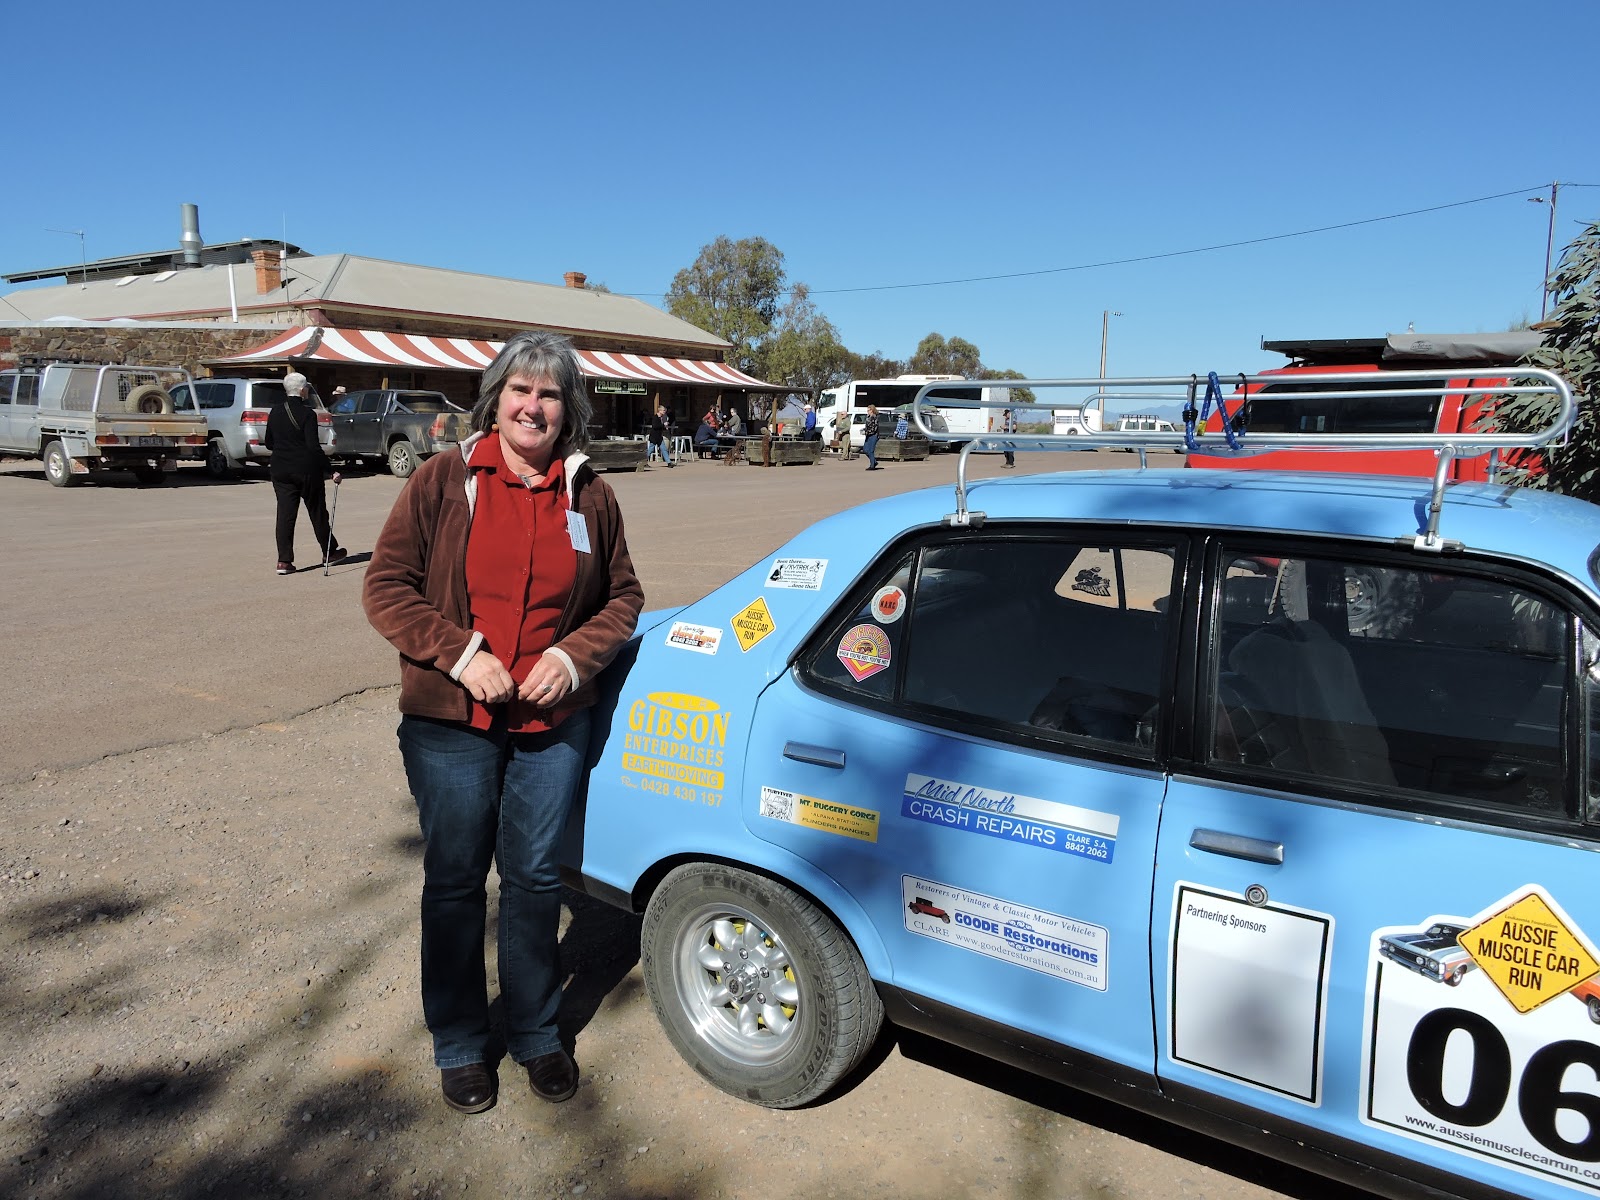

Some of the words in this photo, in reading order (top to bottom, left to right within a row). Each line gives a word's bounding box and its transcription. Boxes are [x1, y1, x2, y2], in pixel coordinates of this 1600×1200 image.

[736, 618, 757, 631] MUSCLE
[756, 623, 769, 633] CAR
[746, 610, 765, 622] AUSSIE
[743, 631, 756, 641] RUN
[628, 699, 731, 748] GIBSON
[624, 733, 724, 767] ENTERPRISES
[627, 755, 720, 787] EARTHMOVING
[641, 778, 670, 796] 0428
[673, 786, 696, 802] 430
[701, 791, 723, 807] 197
[914, 779, 962, 801] Mid
[958, 787, 1016, 815] North
[799, 798, 813, 808] MT.
[813, 802, 849, 815] BUGGERY
[850, 810, 876, 821] GORGE
[909, 801, 969, 826] CRASH
[976, 815, 1056, 845] REPAIRS
[801, 817, 837, 830] FLINDERS
[838, 825, 870, 837] RANGES
[1066, 833, 1090, 845] CLARE
[1094, 838, 1108, 850] S.A.
[1065, 841, 1085, 854] 8842
[1087, 846, 1108, 859] 2062
[653, 897, 669, 922] 657
[915, 881, 950, 898] Restorers
[951, 891, 960, 901] of
[962, 894, 992, 910] Vintage
[993, 903, 1000, 911] &
[1002, 905, 1031, 920] Classic
[1033, 913, 1059, 927] Motor
[1061, 921, 1097, 938] Vehicles
[1186, 904, 1229, 926] Partnering
[1229, 914, 1267, 934] Sponsors
[913, 920, 951, 938] CLARE
[954, 912, 1000, 935] GOODE
[1003, 926, 1099, 964] Restorations
[1500, 921, 1559, 949] AUSSIE
[955, 932, 1099, 984] www.gooderestorations.com.au
[1478, 938, 1543, 969] MUSCLE
[1546, 952, 1580, 977] CAR
[1508, 966, 1543, 991] RUN
[797, 973, 828, 1082] FEDERAL
[1406, 1007, 1600, 1163] 06
